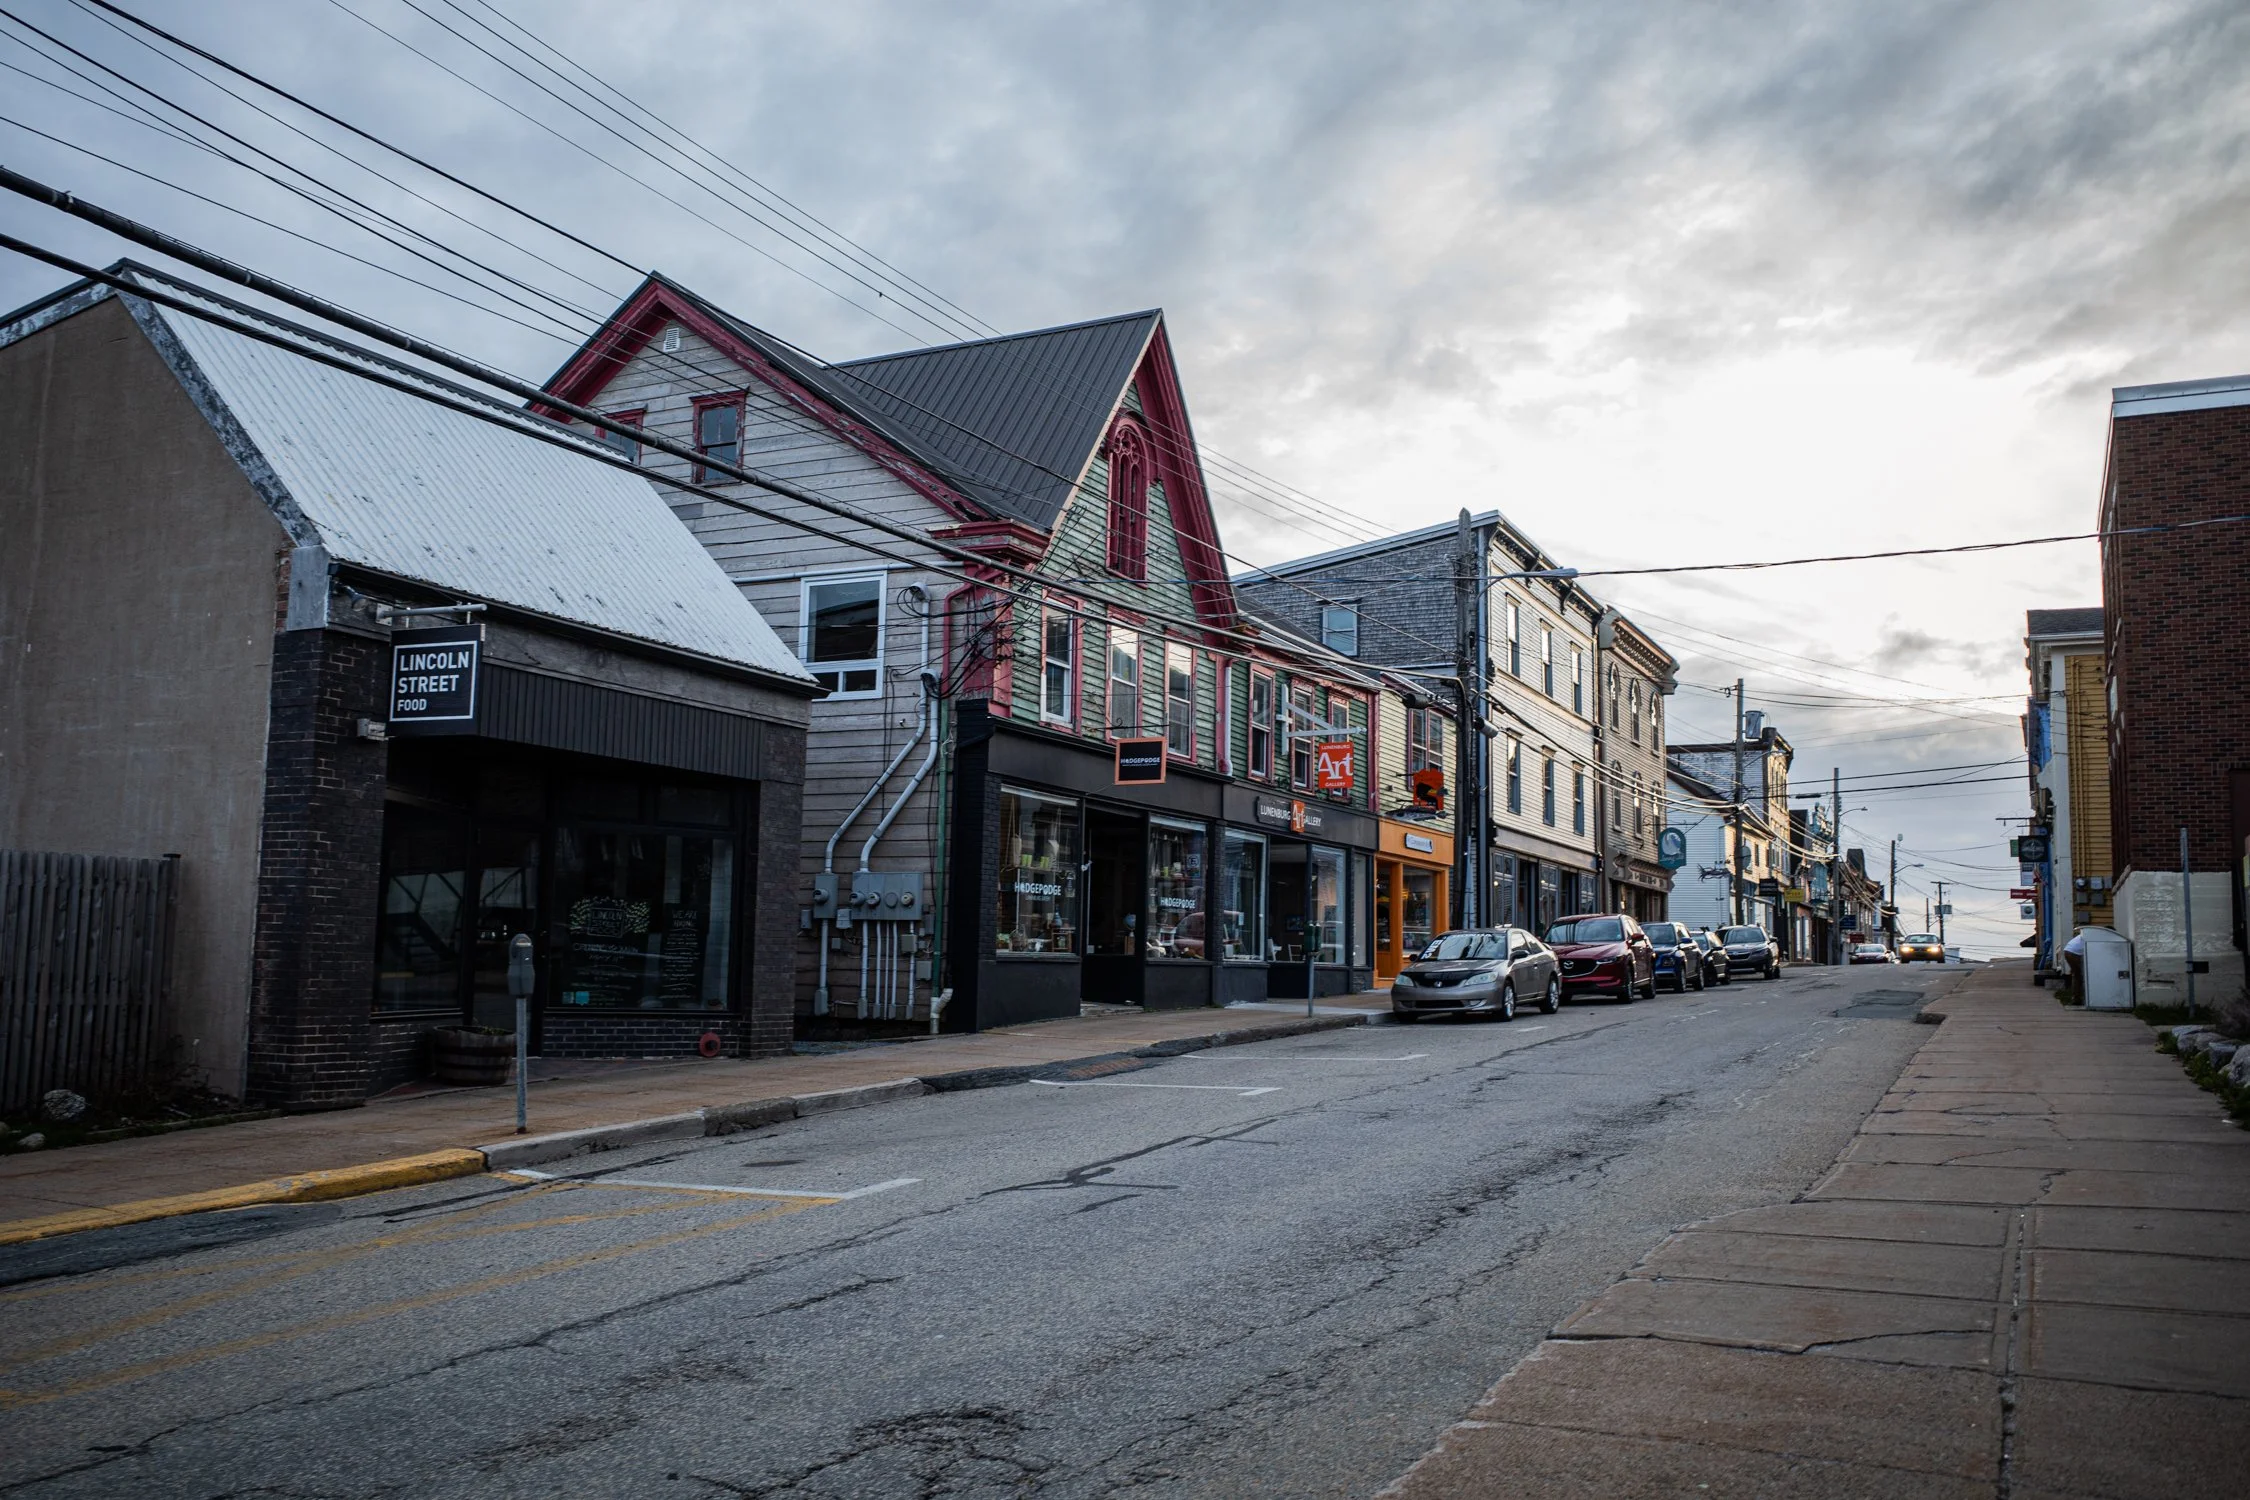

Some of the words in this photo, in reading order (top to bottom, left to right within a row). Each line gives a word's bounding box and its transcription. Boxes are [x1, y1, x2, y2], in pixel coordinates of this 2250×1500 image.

[399, 651, 470, 671] LINCOLN
[397, 674, 460, 694] STREET
[397, 698, 428, 712] FOOD
[1318, 752, 1354, 780] Art
[1260, 804, 1291, 821] LUNENBURG
[1292, 804, 1304, 829] Art
[1014, 881, 1062, 896] HODGEPODGE
